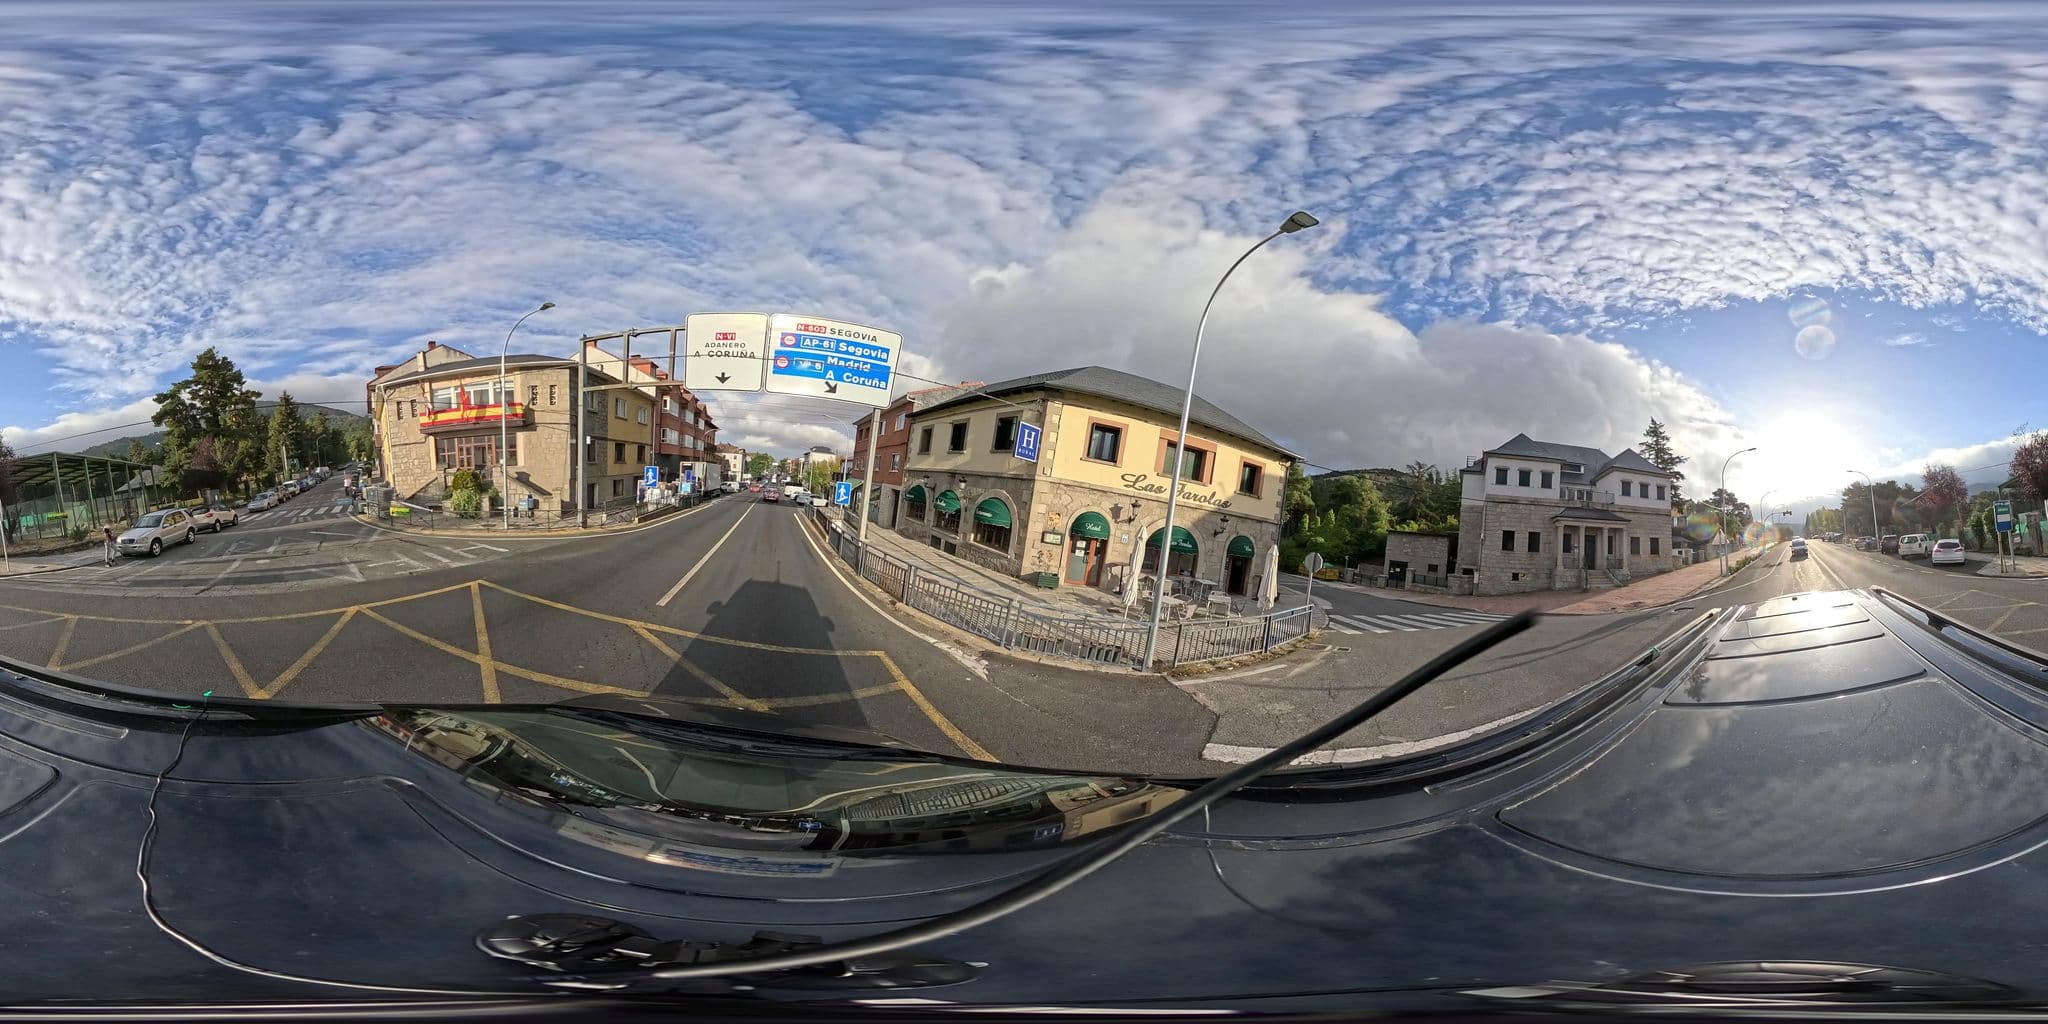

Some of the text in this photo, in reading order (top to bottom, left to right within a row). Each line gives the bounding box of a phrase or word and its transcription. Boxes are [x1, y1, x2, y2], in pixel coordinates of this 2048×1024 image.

[797, 324, 878, 342] N-603 SEGOVIA
[694, 350, 701, 358] A
[803, 338, 835, 349] AP-61
[838, 342, 888, 359] Segovia
[827, 356, 871, 371] Madrid
[825, 370, 887, 389] A Coruña
[1022, 429, 1036, 449] H
[1120, 473, 1167, 494] Las
[1085, 522, 1102, 532] Hotel
